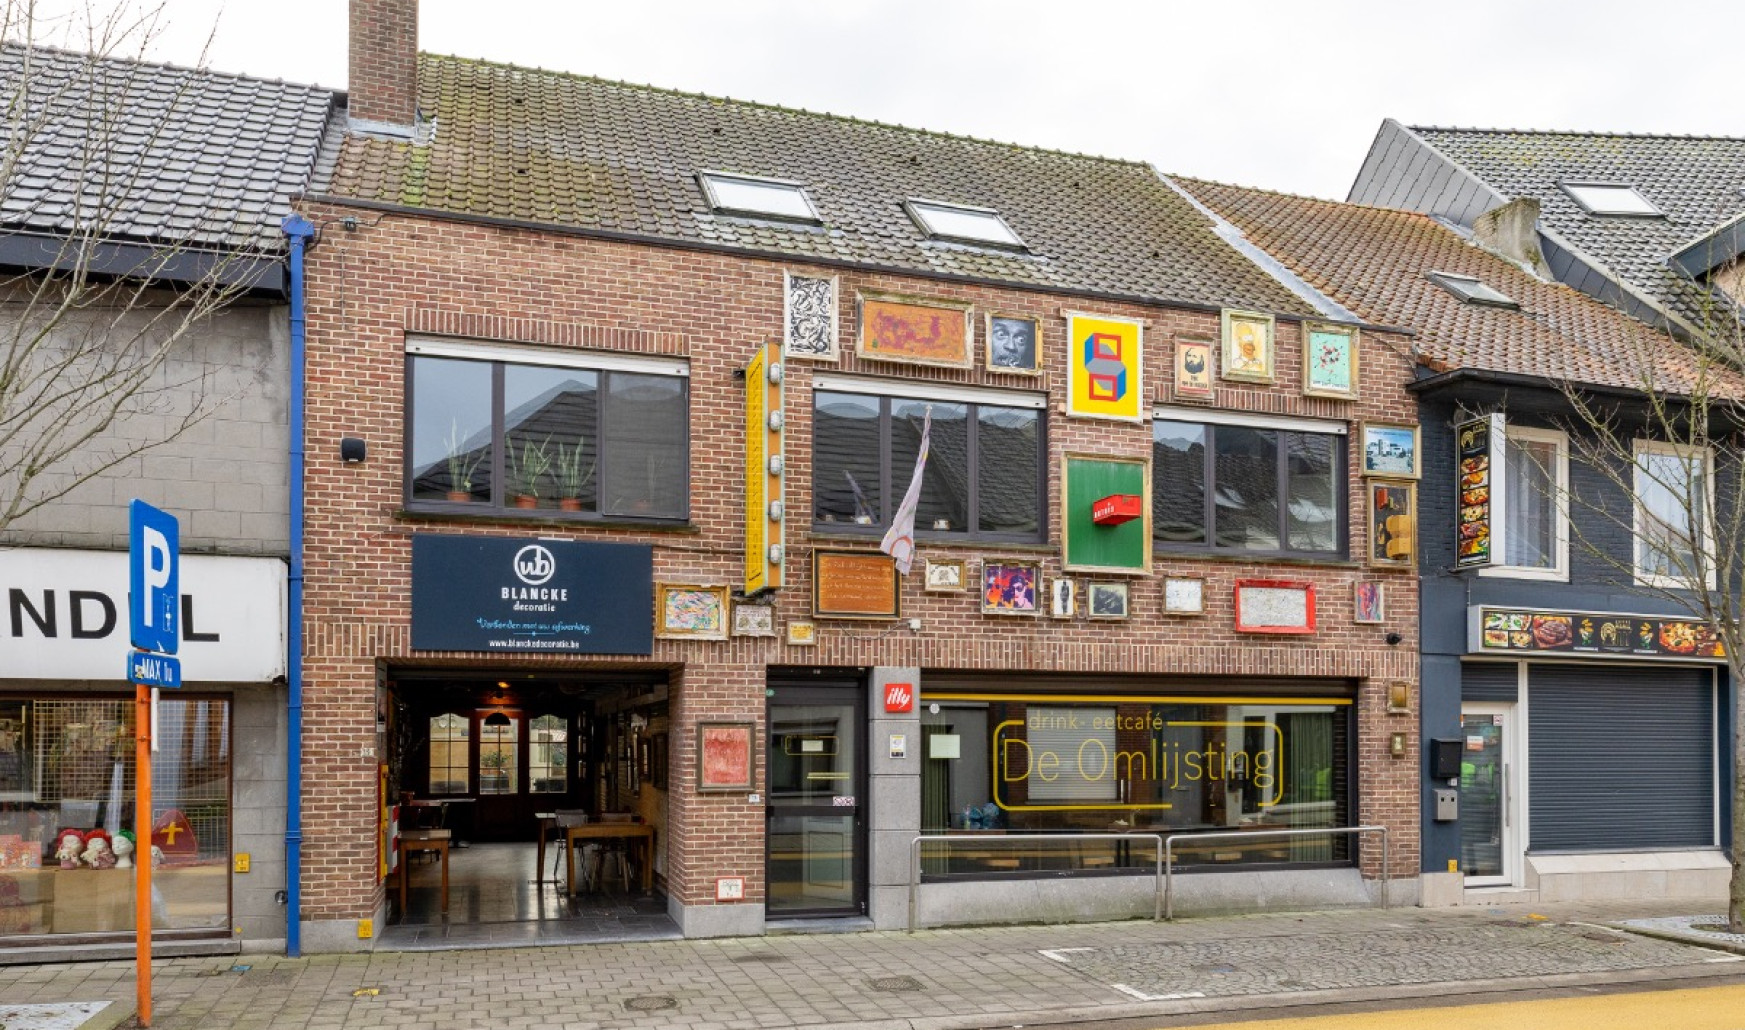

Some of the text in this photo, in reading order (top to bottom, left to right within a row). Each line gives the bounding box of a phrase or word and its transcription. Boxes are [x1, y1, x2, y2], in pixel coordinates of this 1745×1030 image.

[144, 525, 171, 627] P
[501, 587, 568, 601] BLANCKE
[9, 588, 220, 642] NDL
[513, 601, 556, 612] decoratie
[488, 639, 580, 649] www.blanckedecoratie.be
[142, 657, 161, 680] MAX
[887, 688, 910, 709] illy
[1092, 712, 1164, 731] eetcafé
[1004, 738, 1275, 789] De Omlijsting
